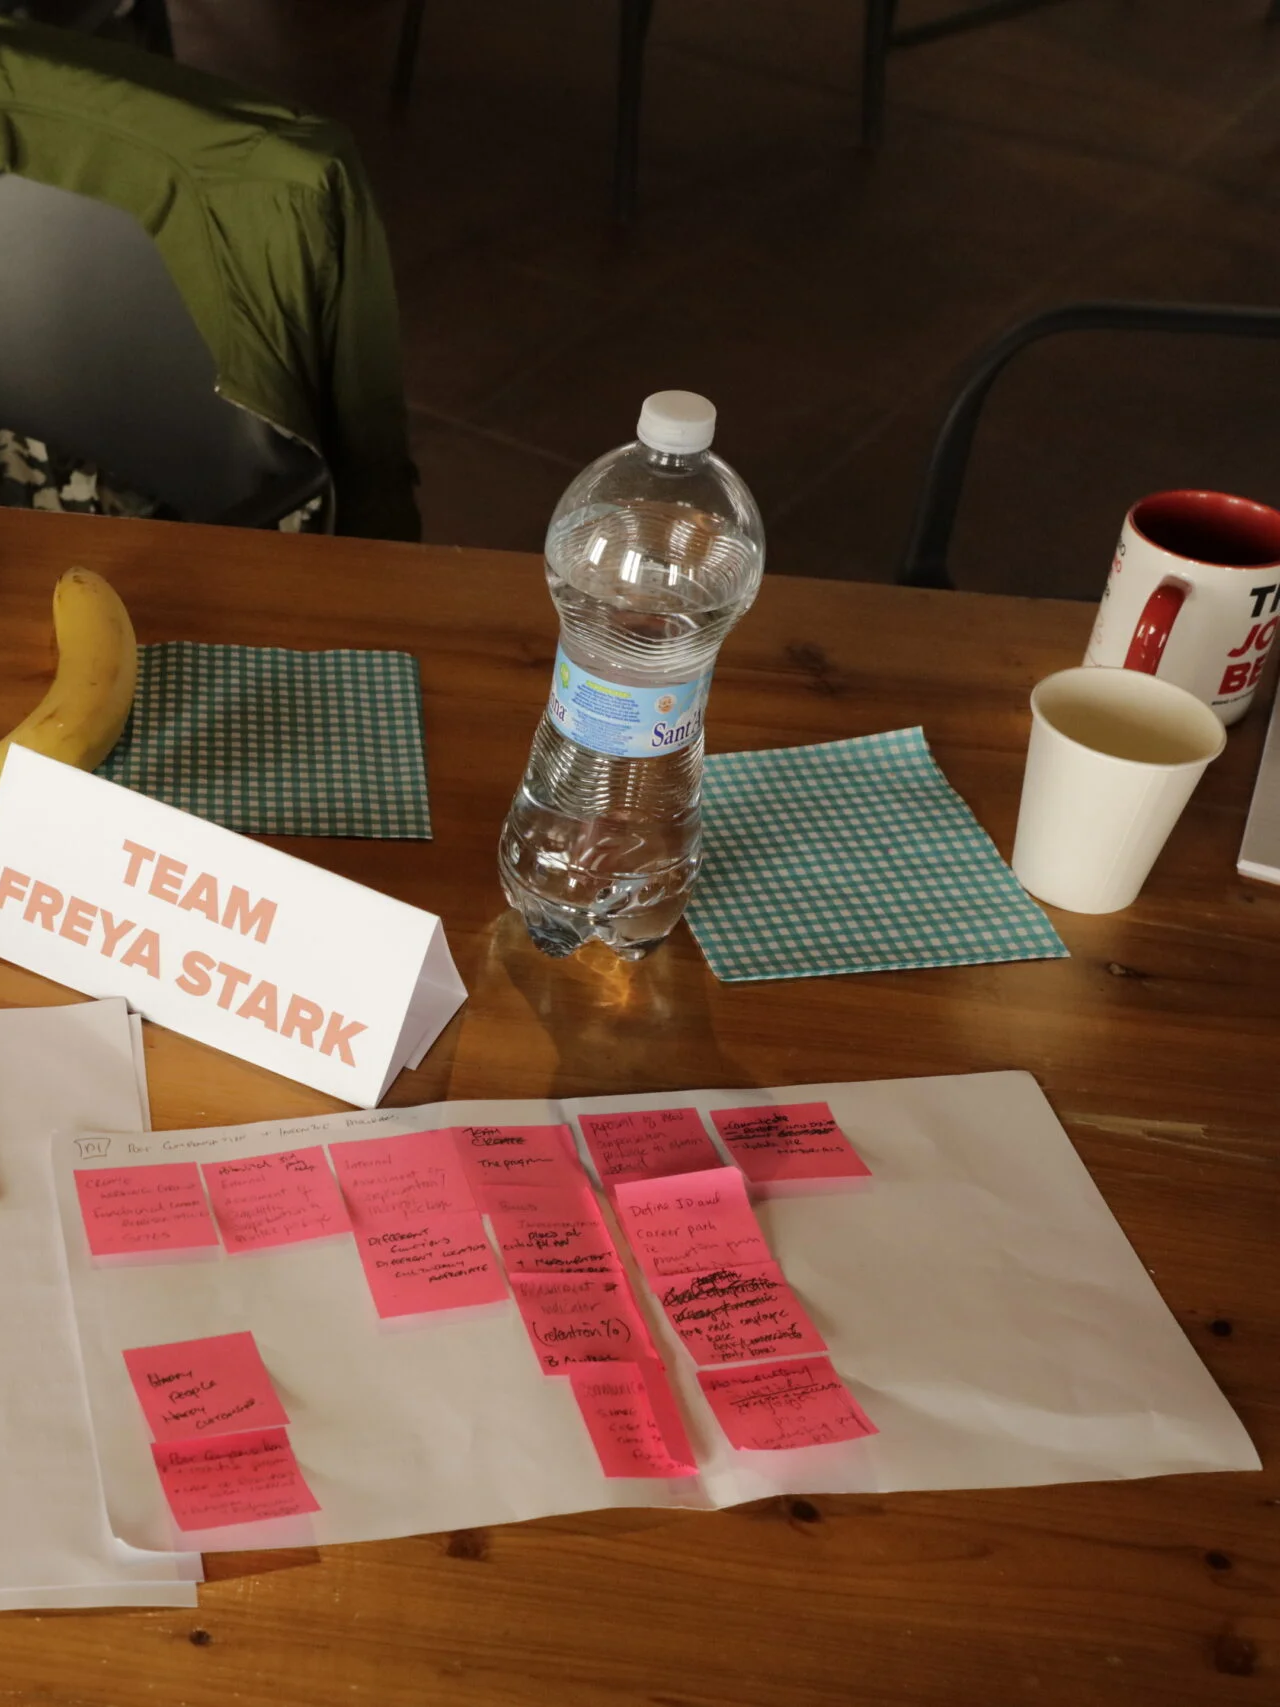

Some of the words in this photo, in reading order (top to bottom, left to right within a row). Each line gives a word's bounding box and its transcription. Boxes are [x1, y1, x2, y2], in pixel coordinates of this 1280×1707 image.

[122, 838, 278, 945] TEAM
[174, 949, 369, 1069] STARK
[630, 1203, 669, 1217] Define
